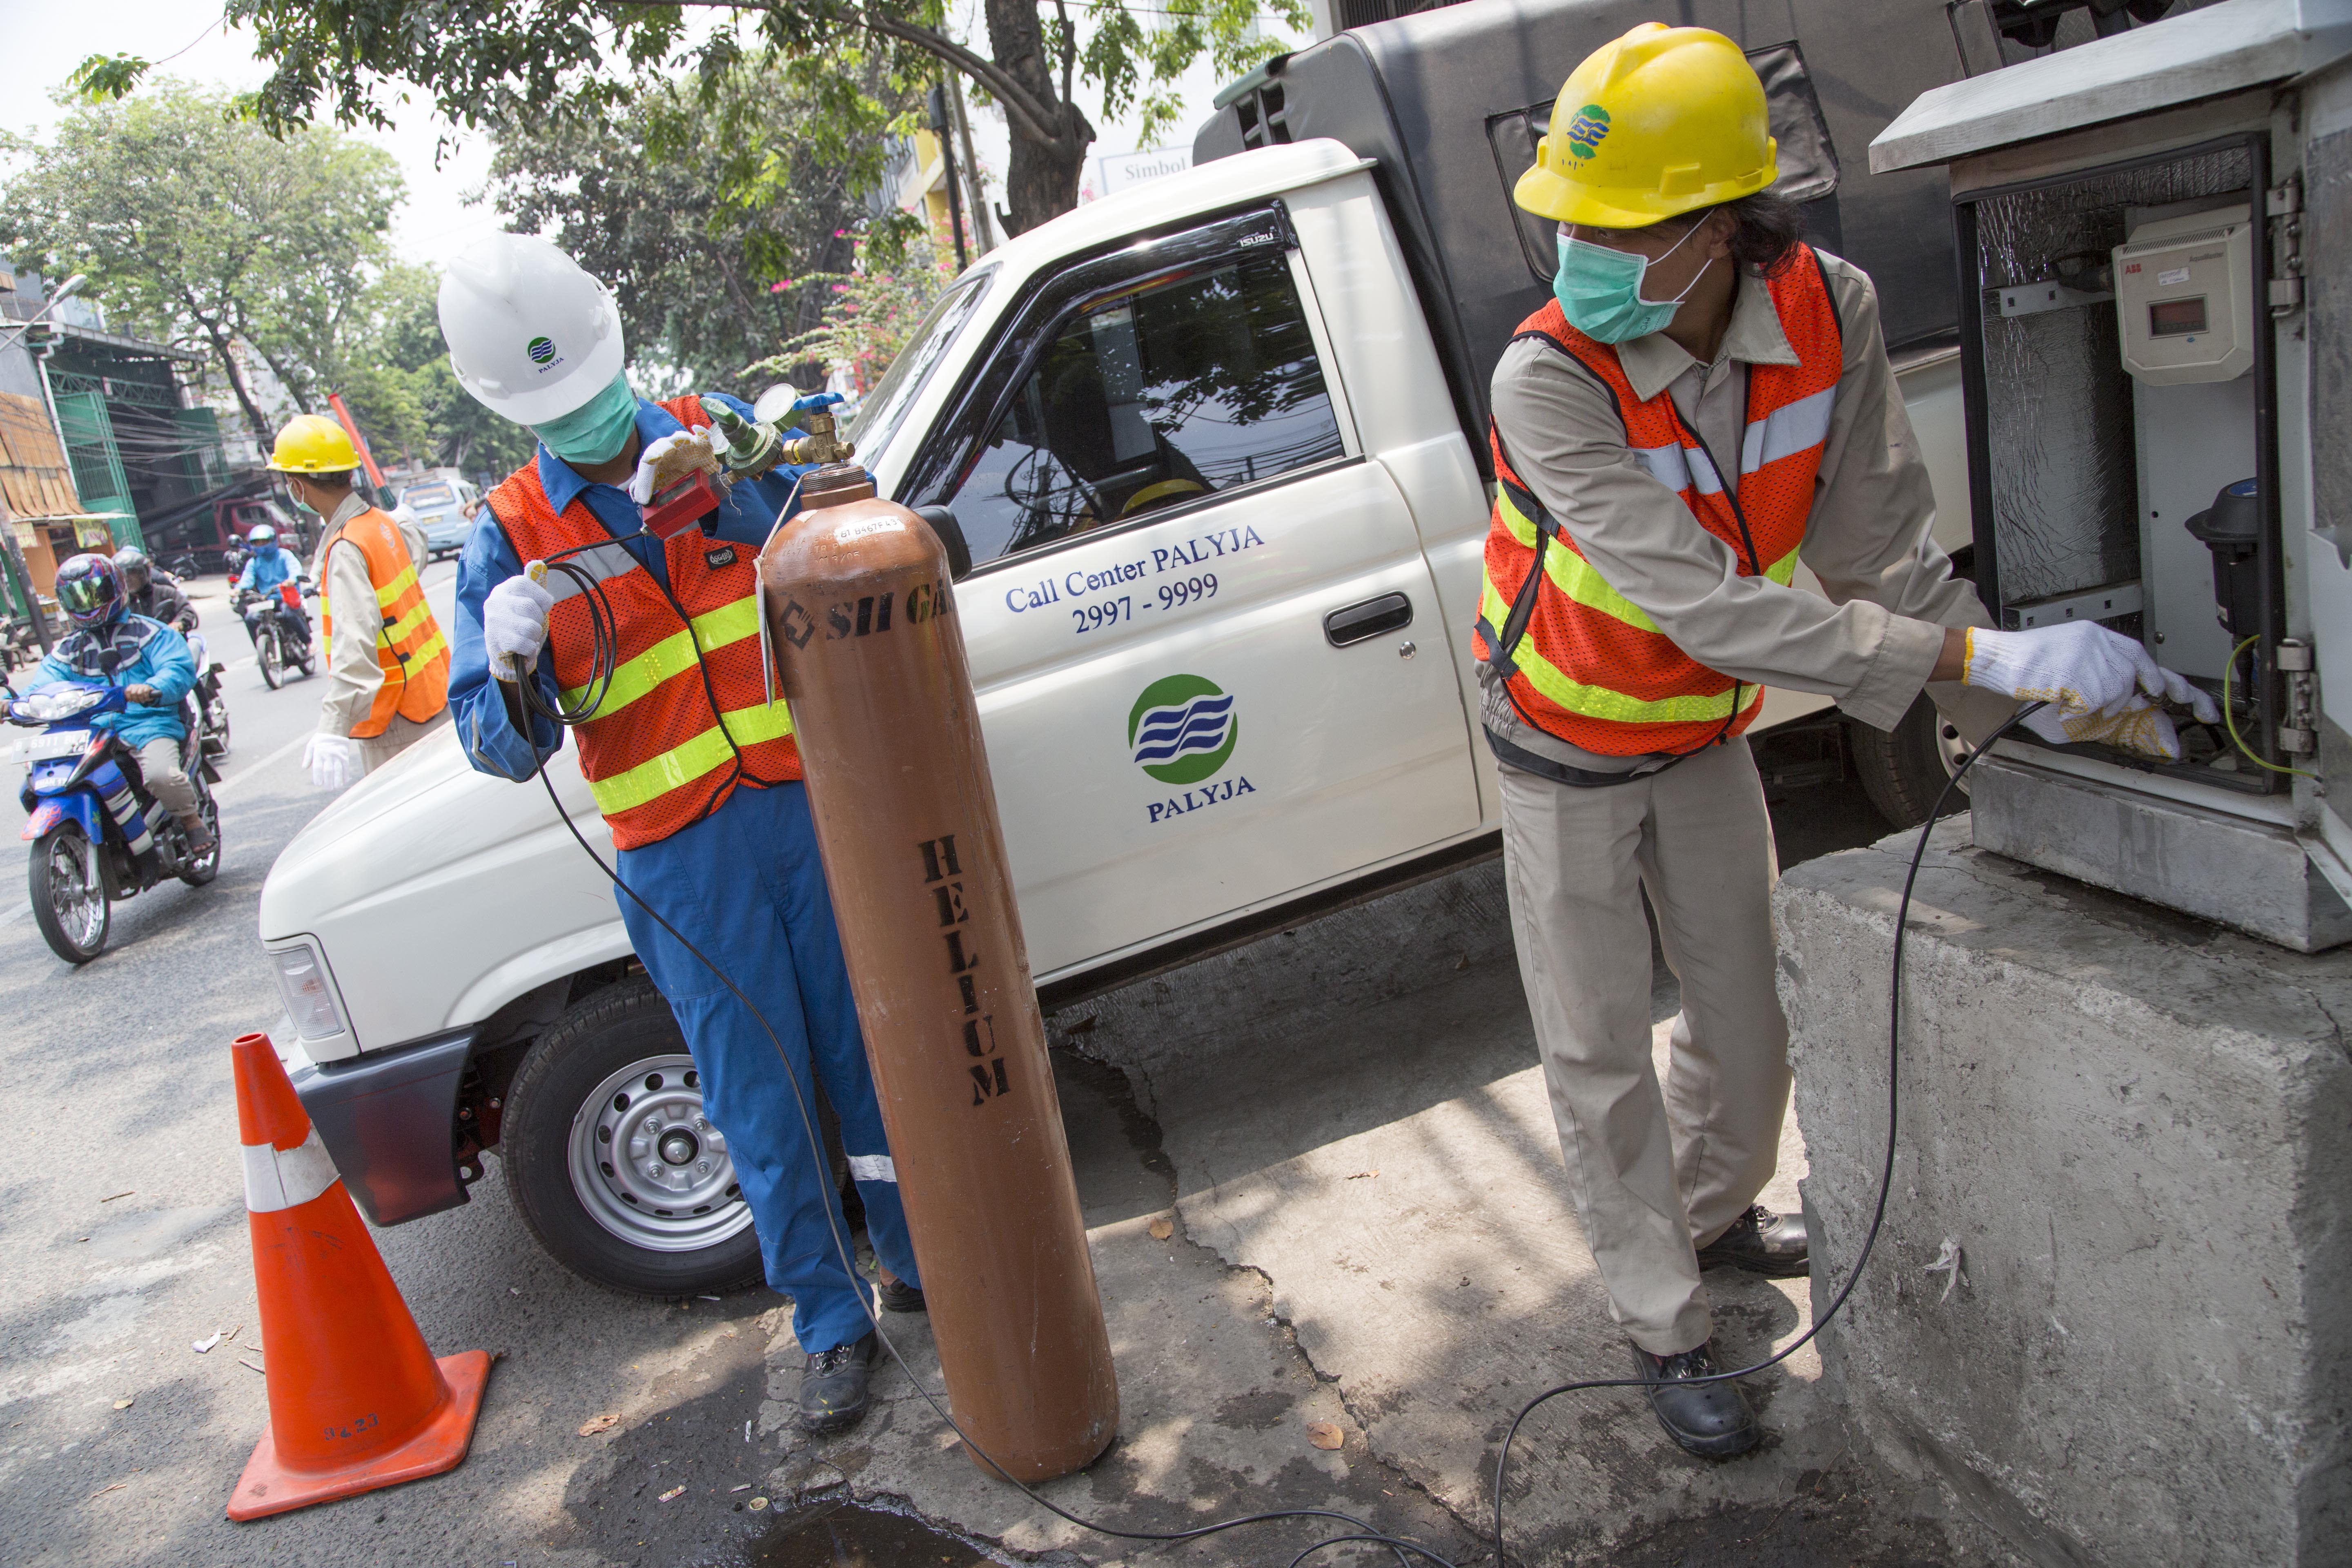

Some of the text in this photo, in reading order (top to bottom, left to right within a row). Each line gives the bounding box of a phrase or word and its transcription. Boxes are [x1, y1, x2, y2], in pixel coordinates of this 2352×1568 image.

[1125, 157, 1186, 180] Simbol
[1240, 232, 1274, 247] ISUZU
[2125, 263, 2142, 275] ABB
[538, 357, 564, 374] PALYJA
[710, 549, 733, 564] ASGARD
[1006, 525, 1265, 612] Call Center PALYJA
[1072, 596, 1131, 633] 2997
[1158, 573, 1218, 610] 9999
[1146, 776, 1256, 823] PALYJA
[918, 834, 1011, 1106] HELIUM
